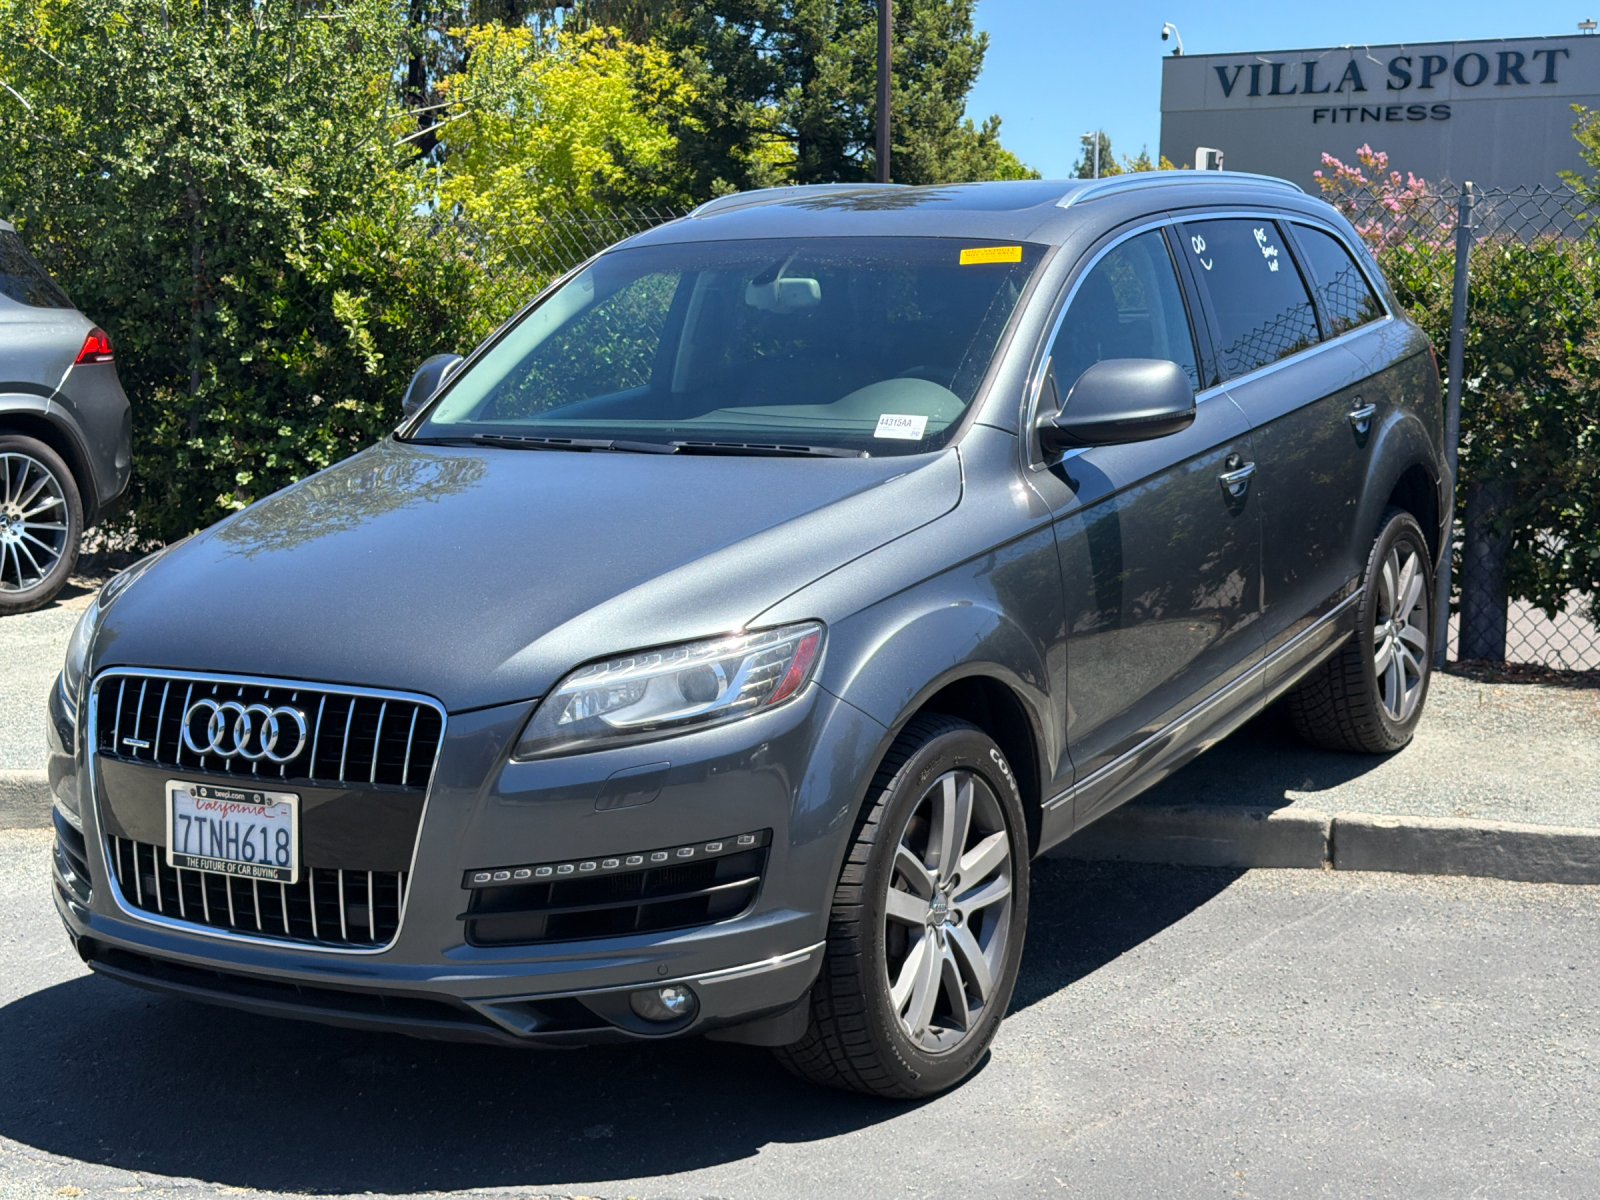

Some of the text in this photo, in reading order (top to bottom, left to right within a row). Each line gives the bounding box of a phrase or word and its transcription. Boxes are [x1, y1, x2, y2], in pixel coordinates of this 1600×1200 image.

[1213, 48, 1570, 98] VILLA SPORT
[1312, 104, 1452, 124] FITNESS
[196, 799, 275, 819] California
[178, 813, 290, 867] 7TNH618
[186, 857, 279, 879] THE FUTURE OF CAR BUYING
